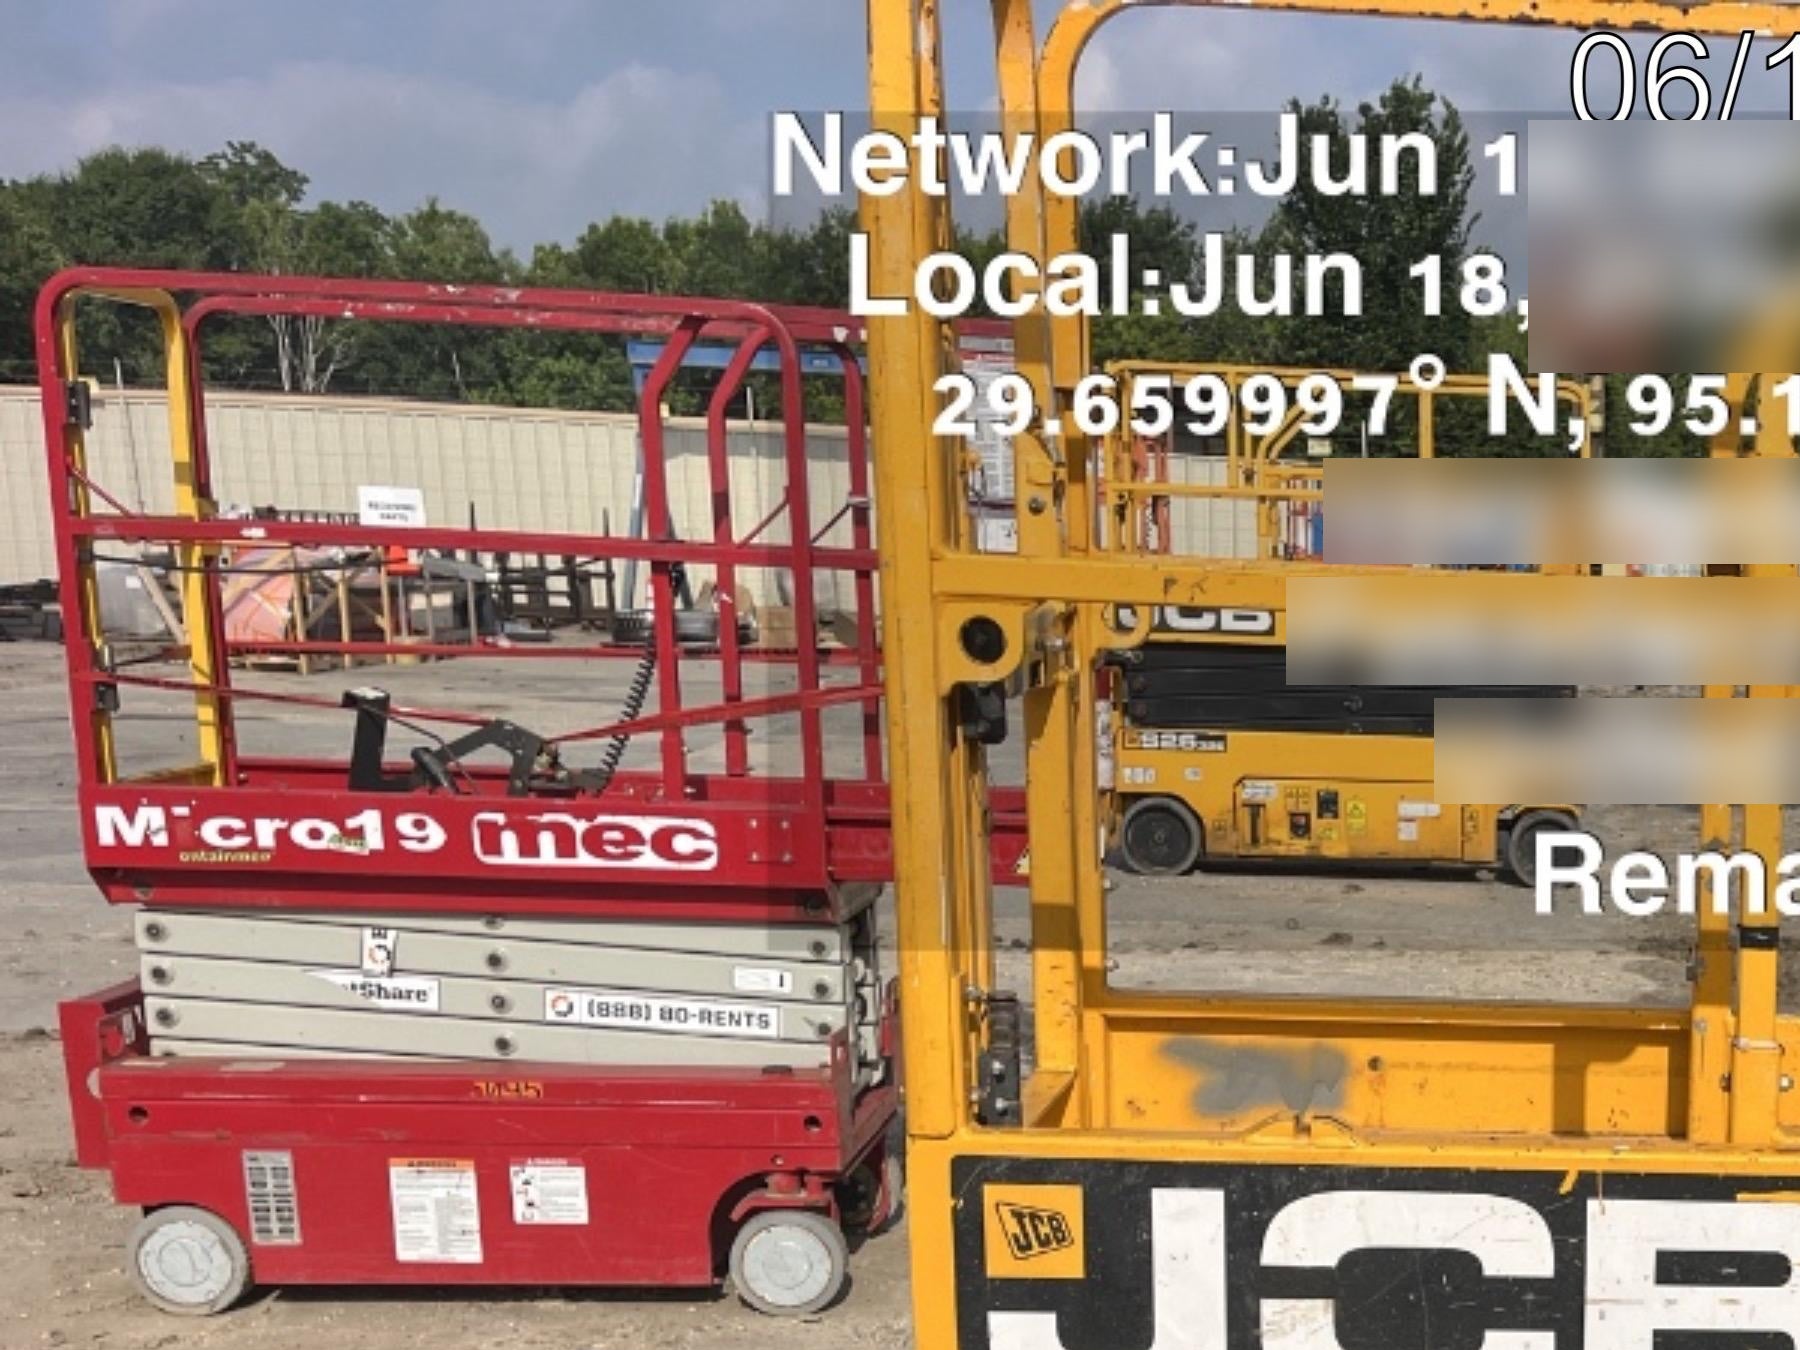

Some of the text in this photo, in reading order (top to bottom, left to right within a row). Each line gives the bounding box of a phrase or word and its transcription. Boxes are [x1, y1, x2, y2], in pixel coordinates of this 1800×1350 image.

[94, 804, 448, 853] Mcro19
[475, 813, 718, 867] mec
[587, 1000, 772, 1030] (888) 80-RENTS
[1003, 1206, 1068, 1255] JCB
